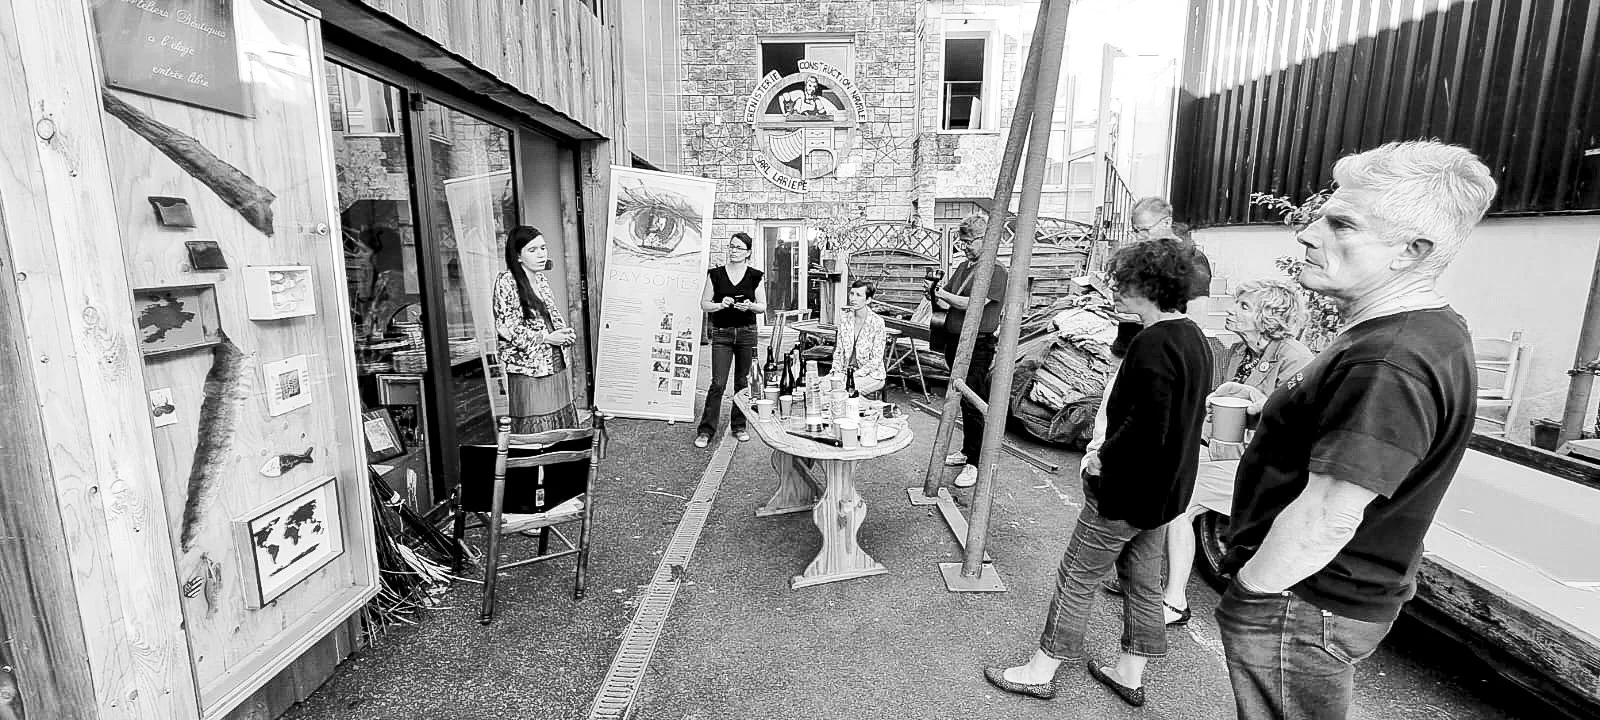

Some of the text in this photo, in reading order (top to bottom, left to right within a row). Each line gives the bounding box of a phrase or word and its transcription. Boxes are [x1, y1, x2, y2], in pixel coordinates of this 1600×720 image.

[799, 61, 866, 121] CONSTRUCTION NAVALE
[755, 154, 771, 175] SARL
